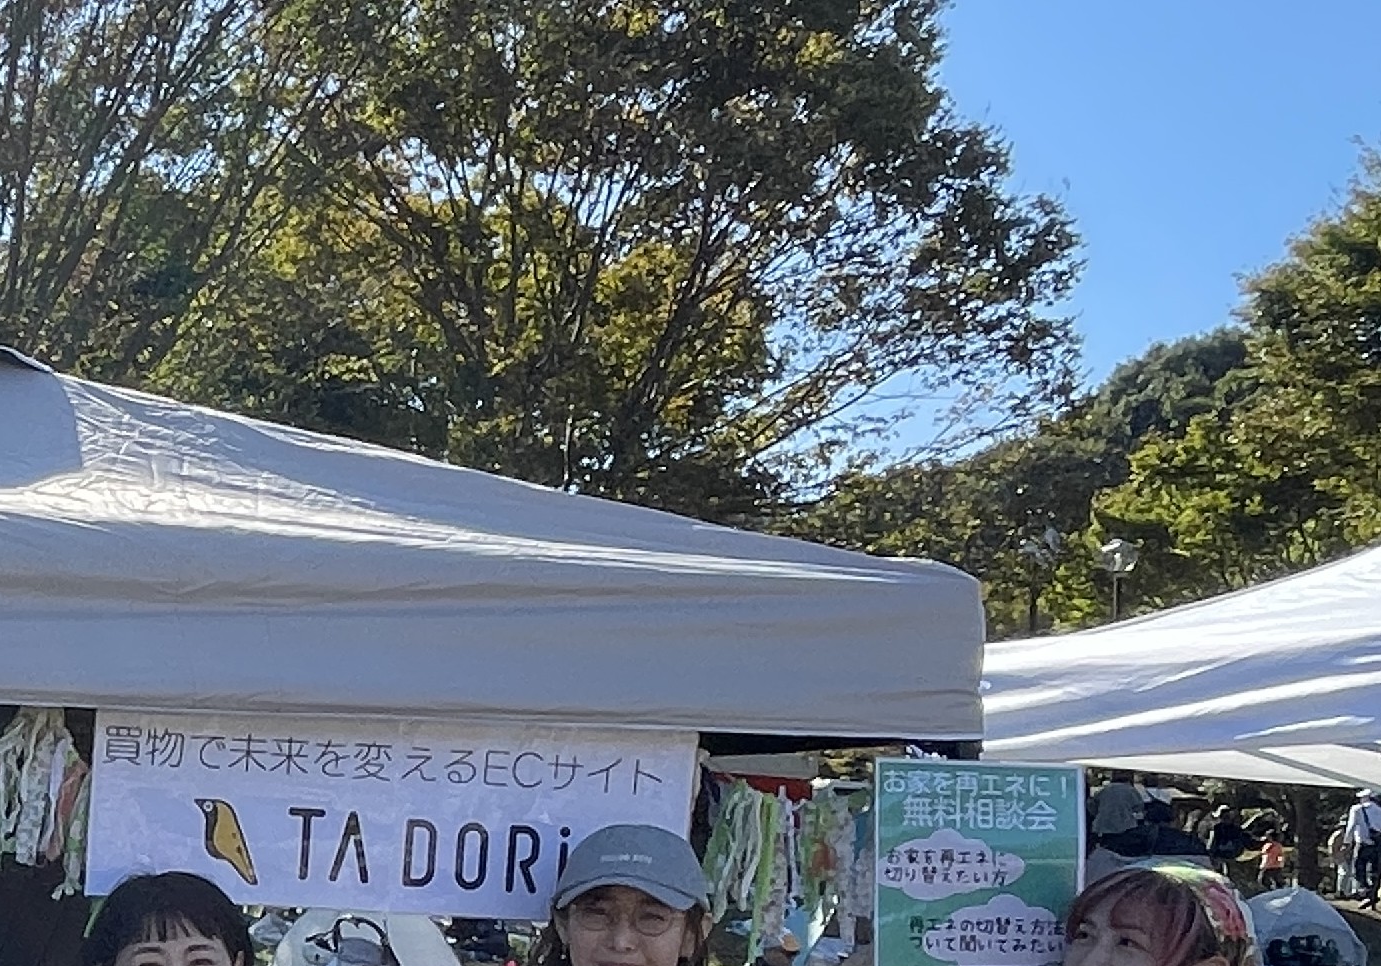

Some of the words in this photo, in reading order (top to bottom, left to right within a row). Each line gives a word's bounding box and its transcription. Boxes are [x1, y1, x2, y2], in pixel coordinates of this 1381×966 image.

[101, 725, 664, 795] 買物で未来を変えるECサイト
[903, 796, 1058, 831] 無料相談会
[884, 867, 1008, 886] 切り替えたい方
